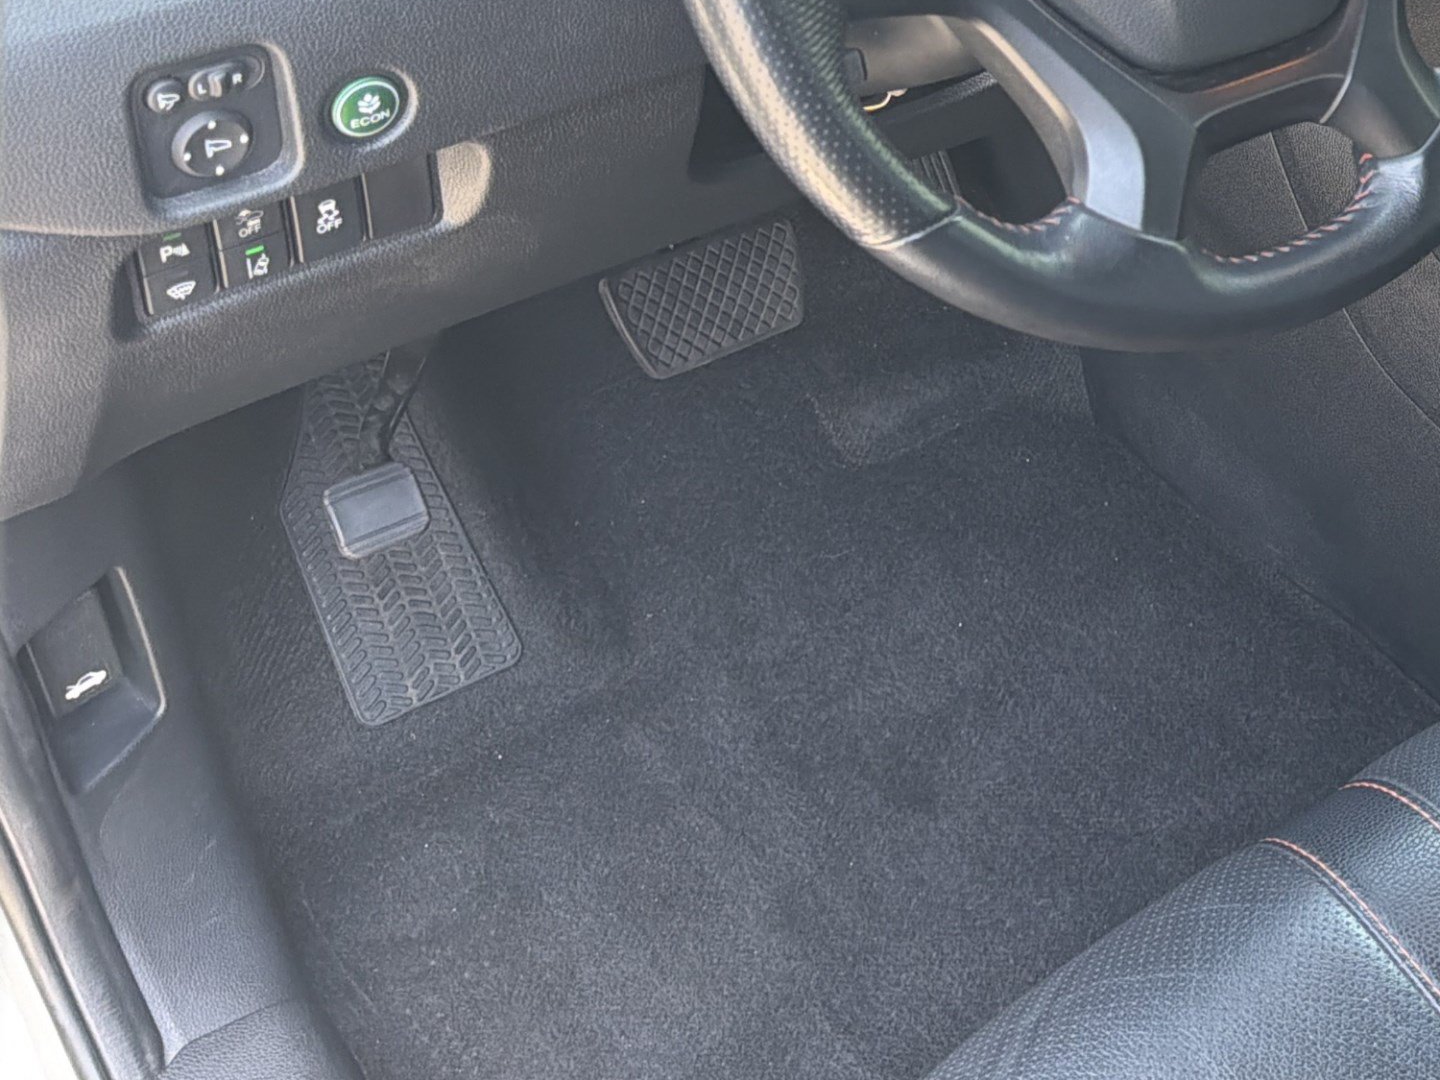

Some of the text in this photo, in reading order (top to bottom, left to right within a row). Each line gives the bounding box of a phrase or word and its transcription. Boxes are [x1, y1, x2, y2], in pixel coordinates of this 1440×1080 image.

[232, 73, 243, 85] R
[197, 84, 207, 95] L
[350, 109, 390, 129] ECON
[238, 224, 262, 238] OFF
[316, 217, 343, 235] OFF
